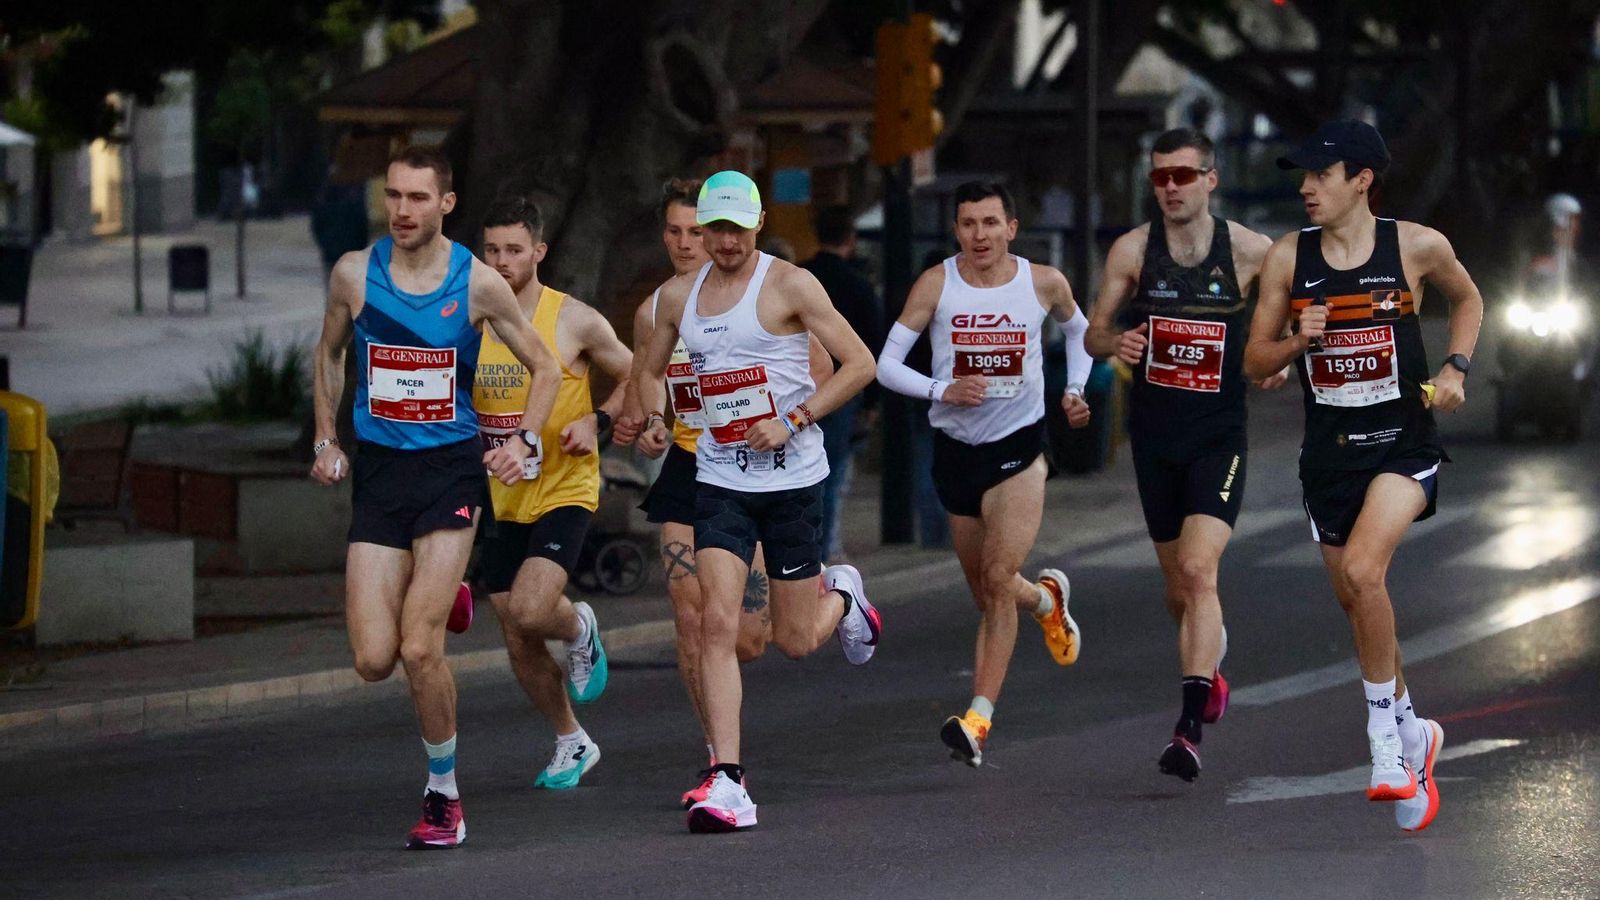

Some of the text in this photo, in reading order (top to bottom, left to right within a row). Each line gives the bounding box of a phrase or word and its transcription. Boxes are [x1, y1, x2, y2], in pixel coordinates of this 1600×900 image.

[951, 314, 1012, 328] GIZA
[1170, 323, 1220, 337] GENERALI
[971, 333, 1021, 344] GENERALI
[1328, 330, 1387, 346] GENERALI
[391, 350, 448, 364] GENERALI
[1167, 344, 1205, 360] 4735
[966, 355, 1011, 368] 13095
[1325, 356, 1377, 373] 15970
[476, 364, 527, 375] VERPOOL
[396, 378, 424, 387] PACER
[475, 376, 523, 387] ARRIERS
[711, 368, 761, 387] GENERALI
[493, 389, 512, 399] A.C.
[685, 386, 700, 398] 10
[716, 398, 750, 410] COLLARD
[486, 416, 521, 427] GENERA
[488, 436, 508, 449] 167
[1223, 454, 1240, 490] TRUE STORY
